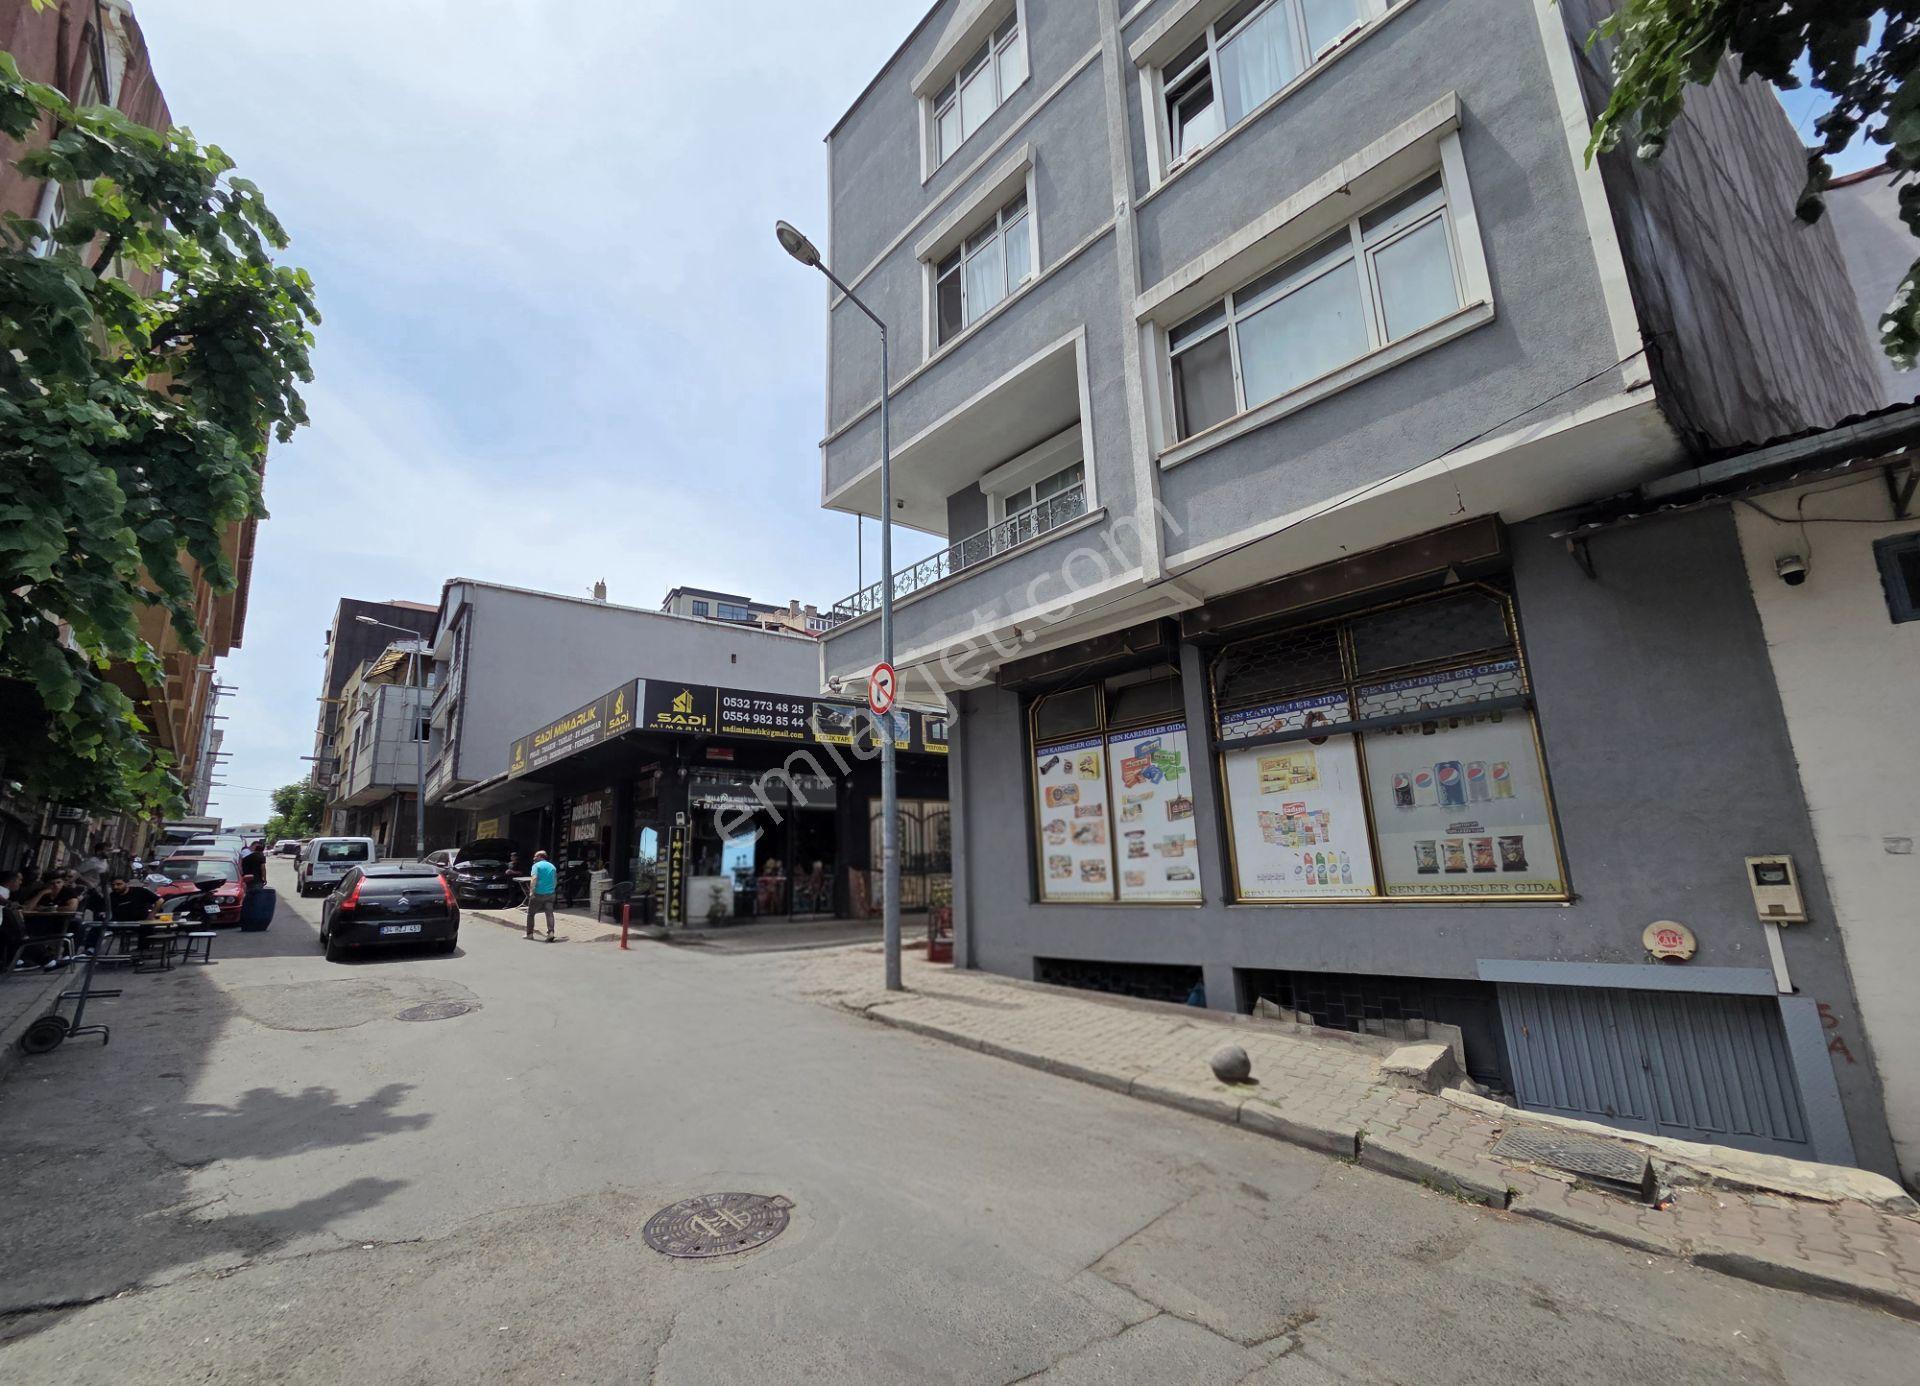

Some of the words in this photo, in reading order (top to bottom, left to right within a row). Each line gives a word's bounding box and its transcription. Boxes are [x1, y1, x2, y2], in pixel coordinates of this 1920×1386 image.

[723, 697, 751, 709] 0532
[753, 700, 773, 711] 773
[775, 702, 789, 713] 48
[791, 704, 805, 714] 25
[722, 711, 750, 723] 0554
[753, 713, 773, 726] 982
[775, 716, 789, 726] 85
[791, 717, 804, 727] 44
[1514, 883, 1557, 892] GIDA
